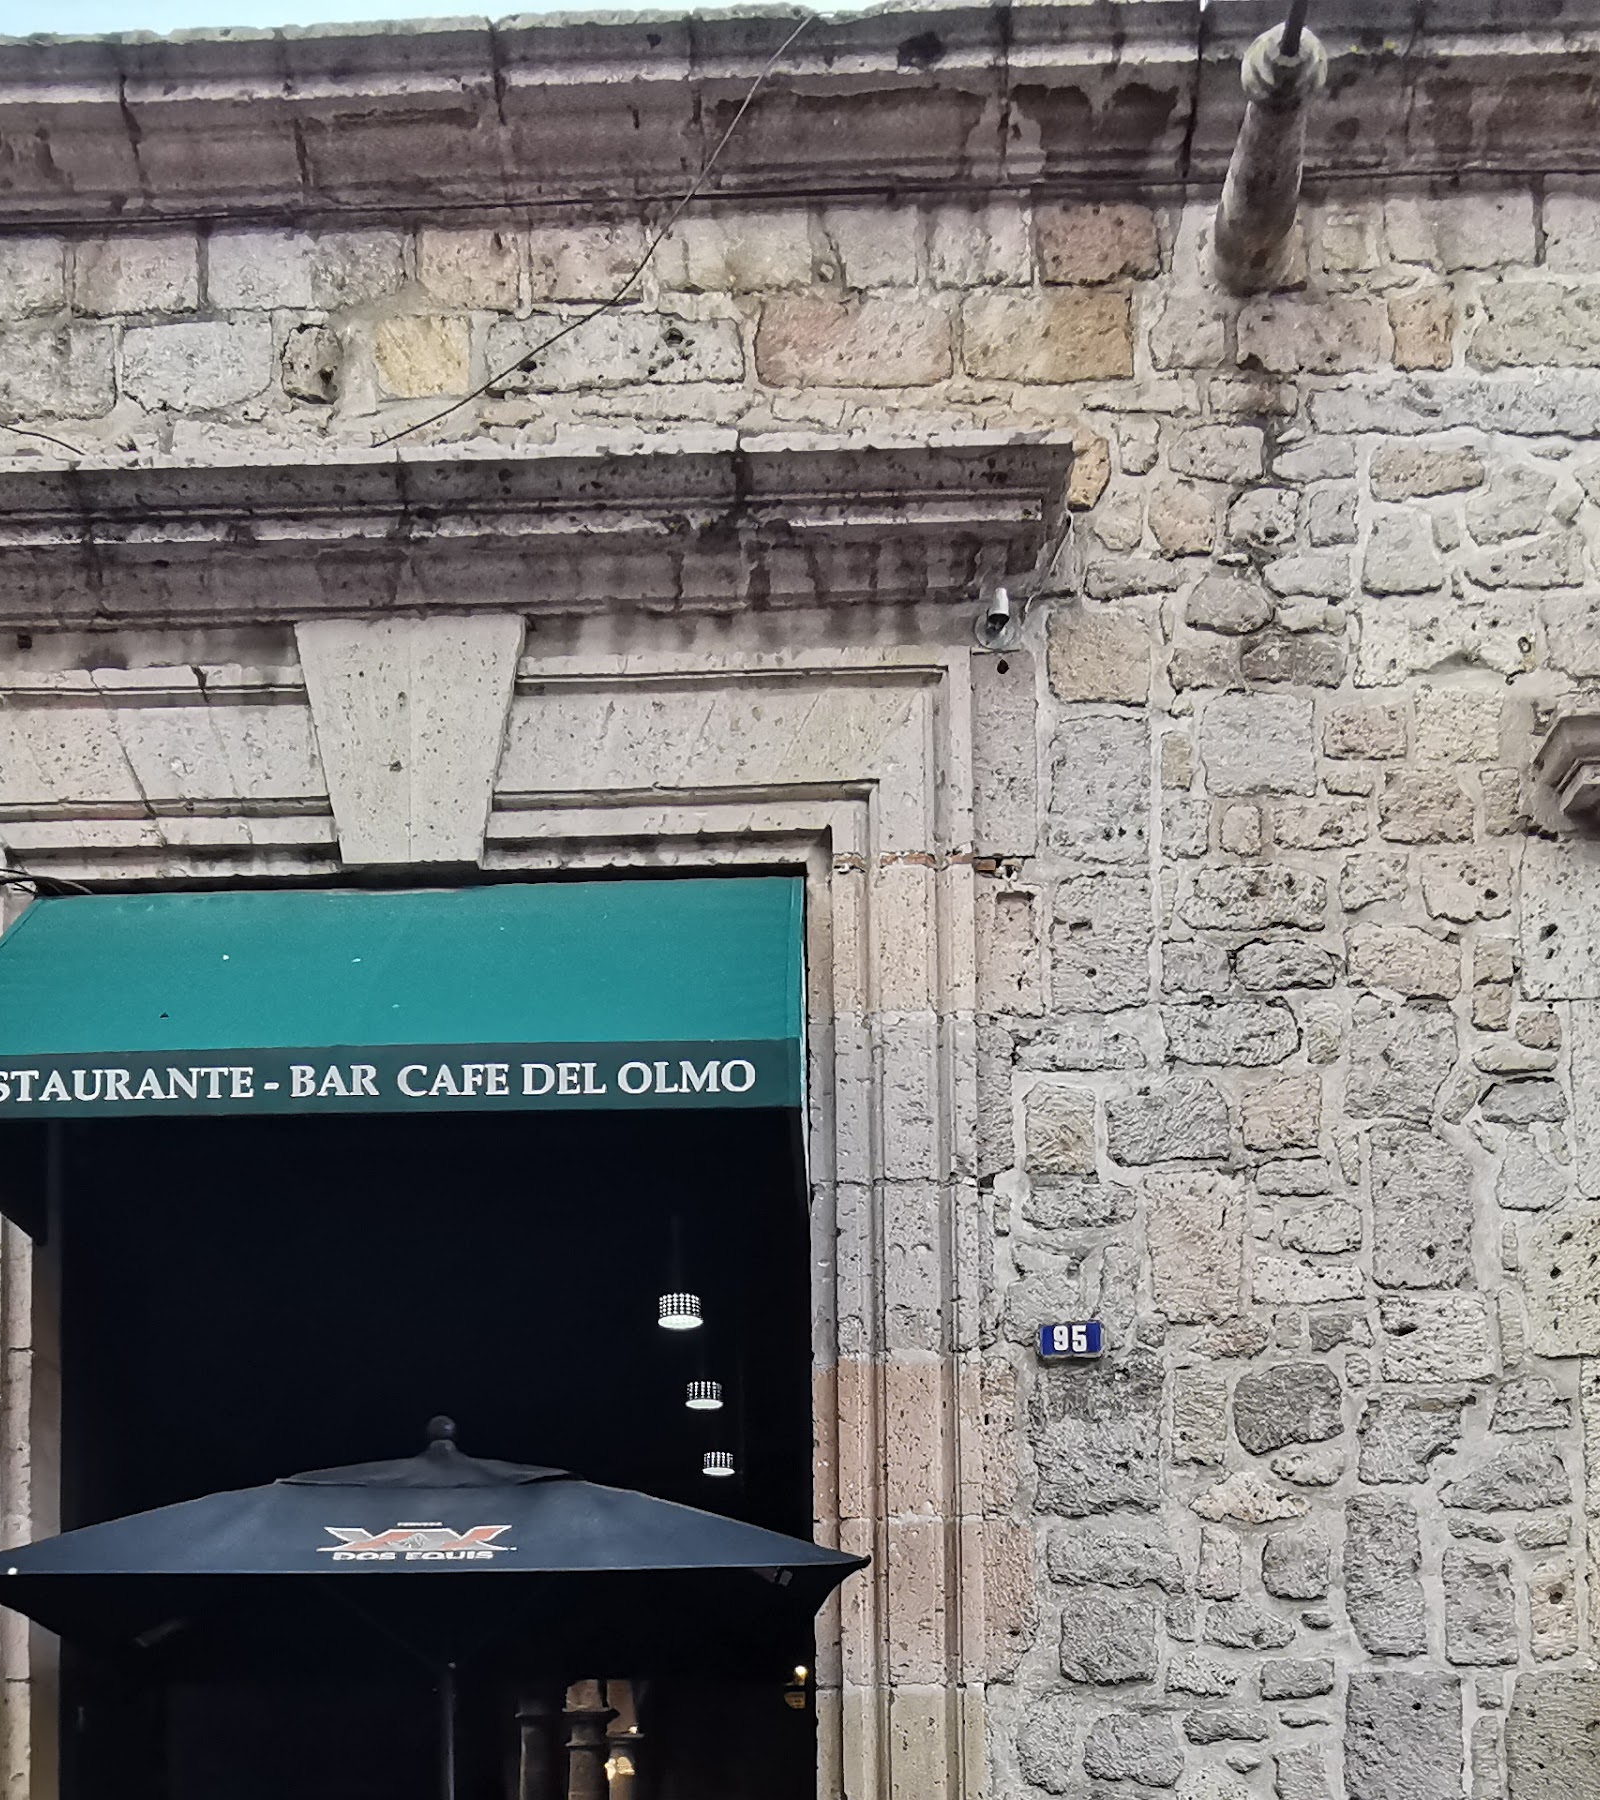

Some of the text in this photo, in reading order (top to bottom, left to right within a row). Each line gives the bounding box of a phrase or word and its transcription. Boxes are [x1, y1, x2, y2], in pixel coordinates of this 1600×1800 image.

[289, 1064, 380, 1098] BAR
[396, 1062, 511, 1097] CAFE
[520, 1061, 607, 1096] DEL
[616, 1059, 758, 1094] OLMO
[1052, 1324, 1088, 1353] 95
[332, 1549, 495, 1561] DOS EQUIS
